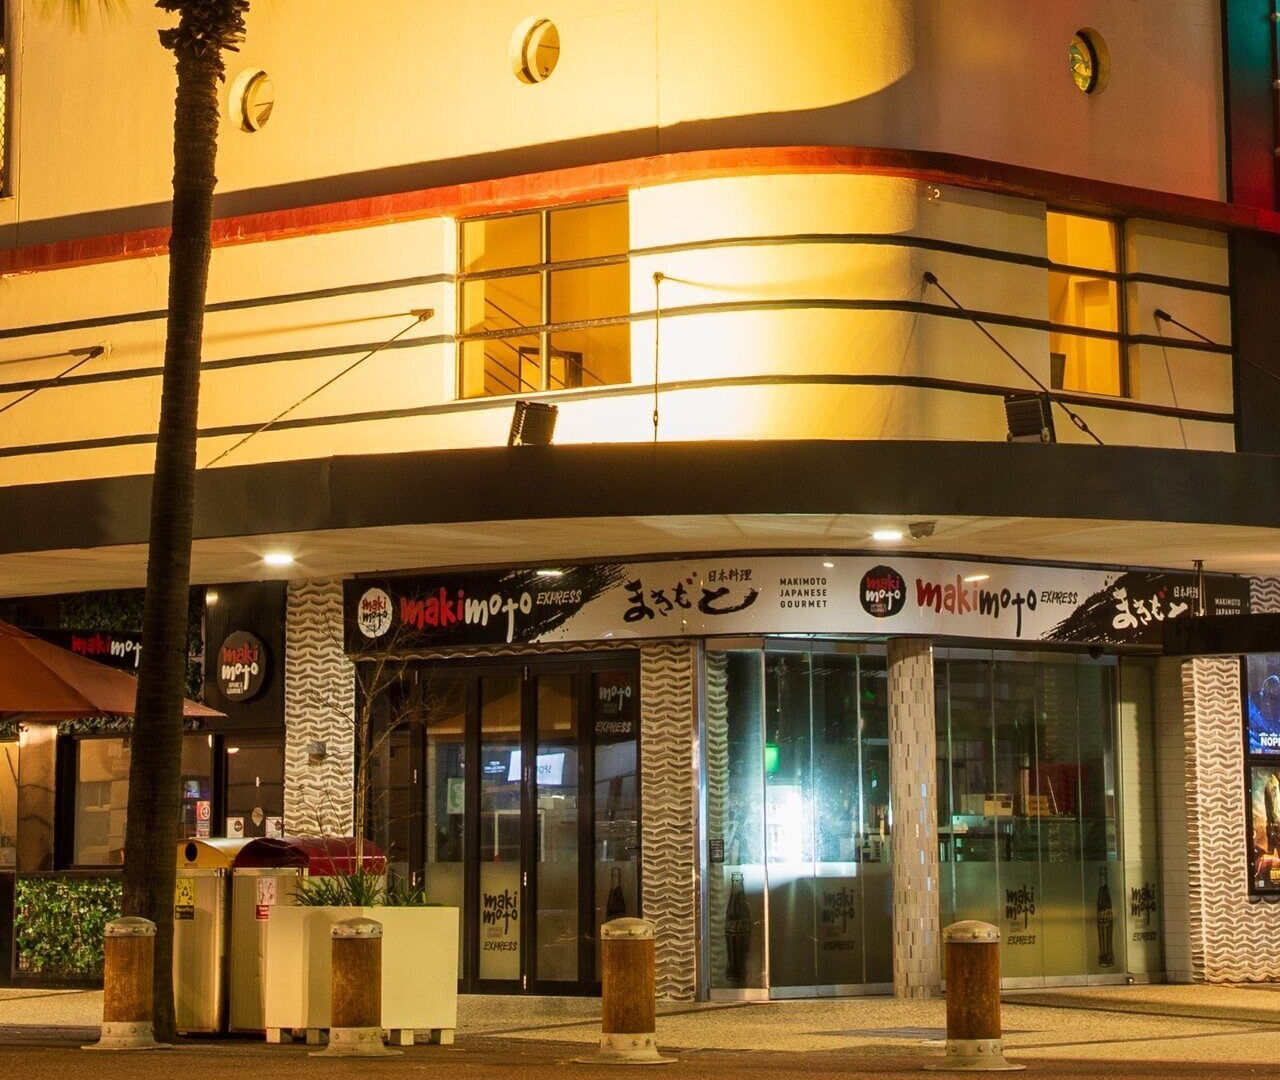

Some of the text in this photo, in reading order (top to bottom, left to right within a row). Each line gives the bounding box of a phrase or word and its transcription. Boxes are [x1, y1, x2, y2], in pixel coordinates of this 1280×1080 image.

[708, 569, 752, 582] 日本料理
[780, 578, 827, 586] MAKIMOTO
[867, 575, 900, 590] maki
[536, 590, 582, 604] EXPRESS
[780, 589, 827, 597] JAPANESE
[865, 589, 900, 610] moto
[1040, 591, 1078, 604] EXPRESS
[1215, 598, 1241, 606] MAKIMOTO
[780, 600, 827, 608] GOURMET
[72, 633, 142, 667] makimot
[222, 642, 259, 663] maki
[221, 662, 259, 690] moto
[595, 721, 632, 733] EXPRESS
[483, 889, 518, 911] maki
[822, 887, 854, 908] maki
[1005, 884, 1035, 905] maki
[1131, 883, 1156, 904] maki
[482, 908, 518, 935] moto
[1005, 904, 1036, 930] moto
[1131, 901, 1156, 925] moto
[483, 941, 518, 952] EXPRESS
[1007, 934, 1036, 946] EXPRESS
